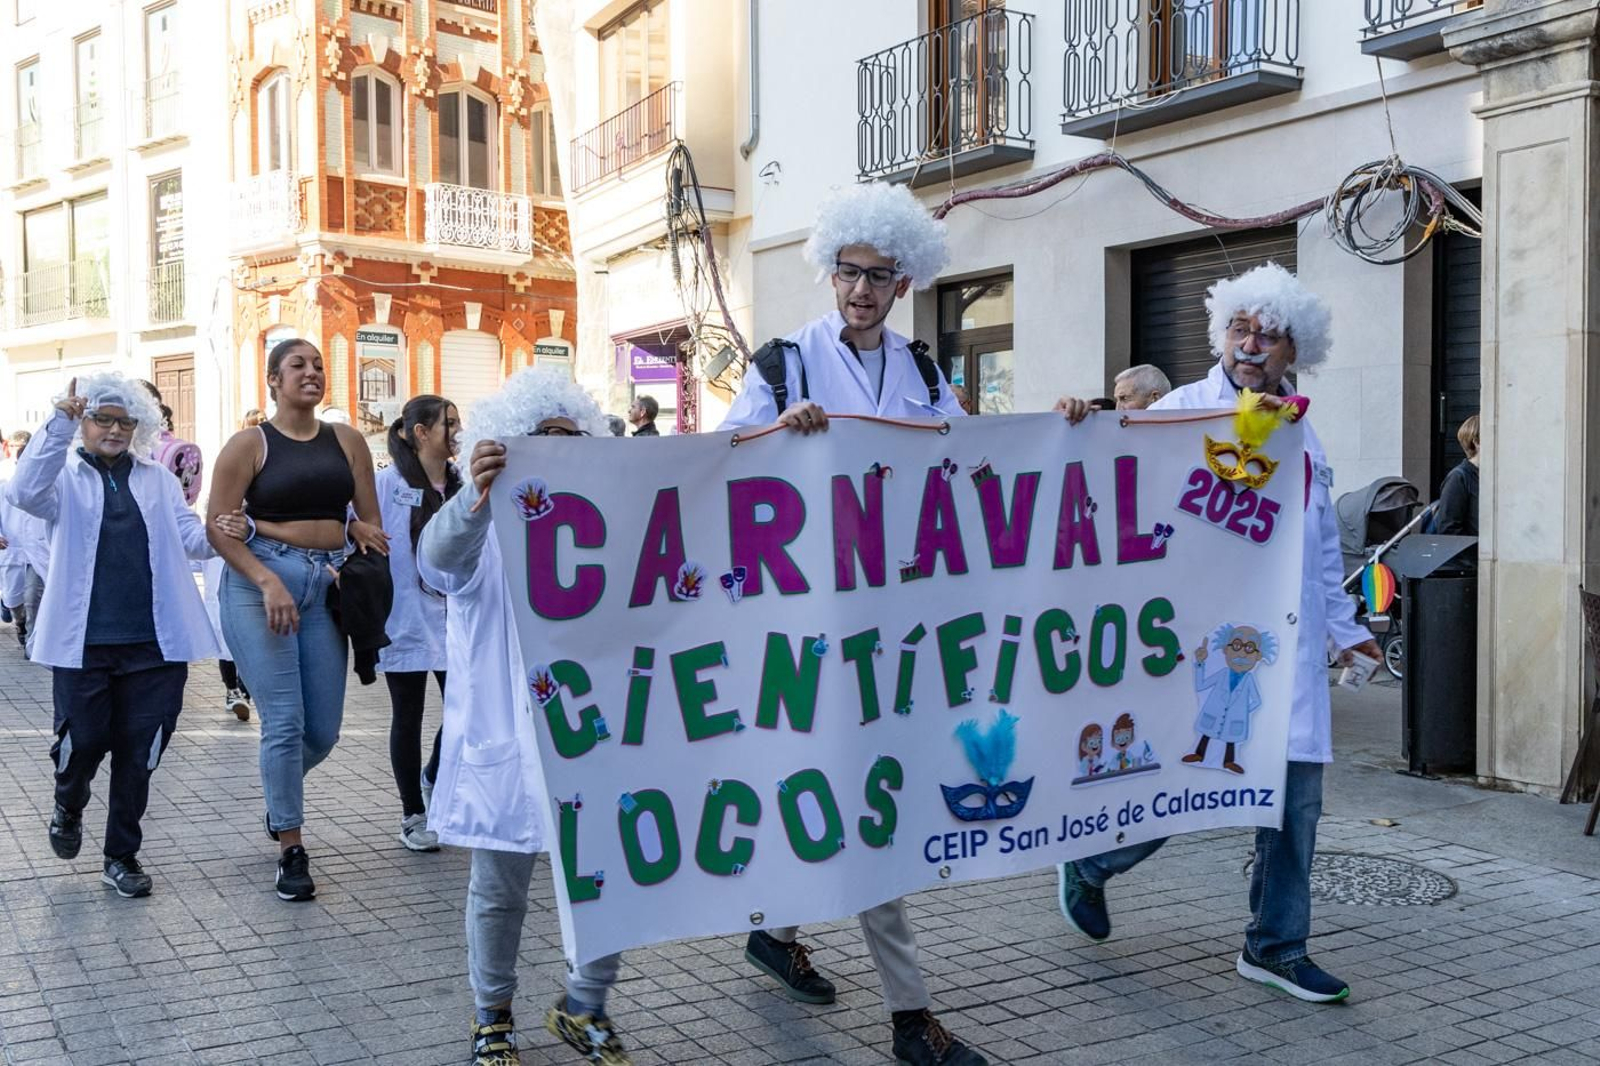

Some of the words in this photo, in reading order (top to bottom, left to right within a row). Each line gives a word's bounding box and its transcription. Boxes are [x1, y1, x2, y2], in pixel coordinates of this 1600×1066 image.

[357, 332, 365, 340] En
[367, 333, 394, 344] alquiler
[542, 347, 565, 356] alquiler
[525, 455, 1168, 620] CARNAVAL
[1179, 467, 1282, 544] 2025
[558, 755, 905, 904] LOCOS
[923, 829, 989, 864] CEIP
[999, 825, 1049, 854] San
[1056, 806, 1109, 842] José
[1117, 800, 1145, 828] de
[1152, 786, 1275, 819] Calasanz
